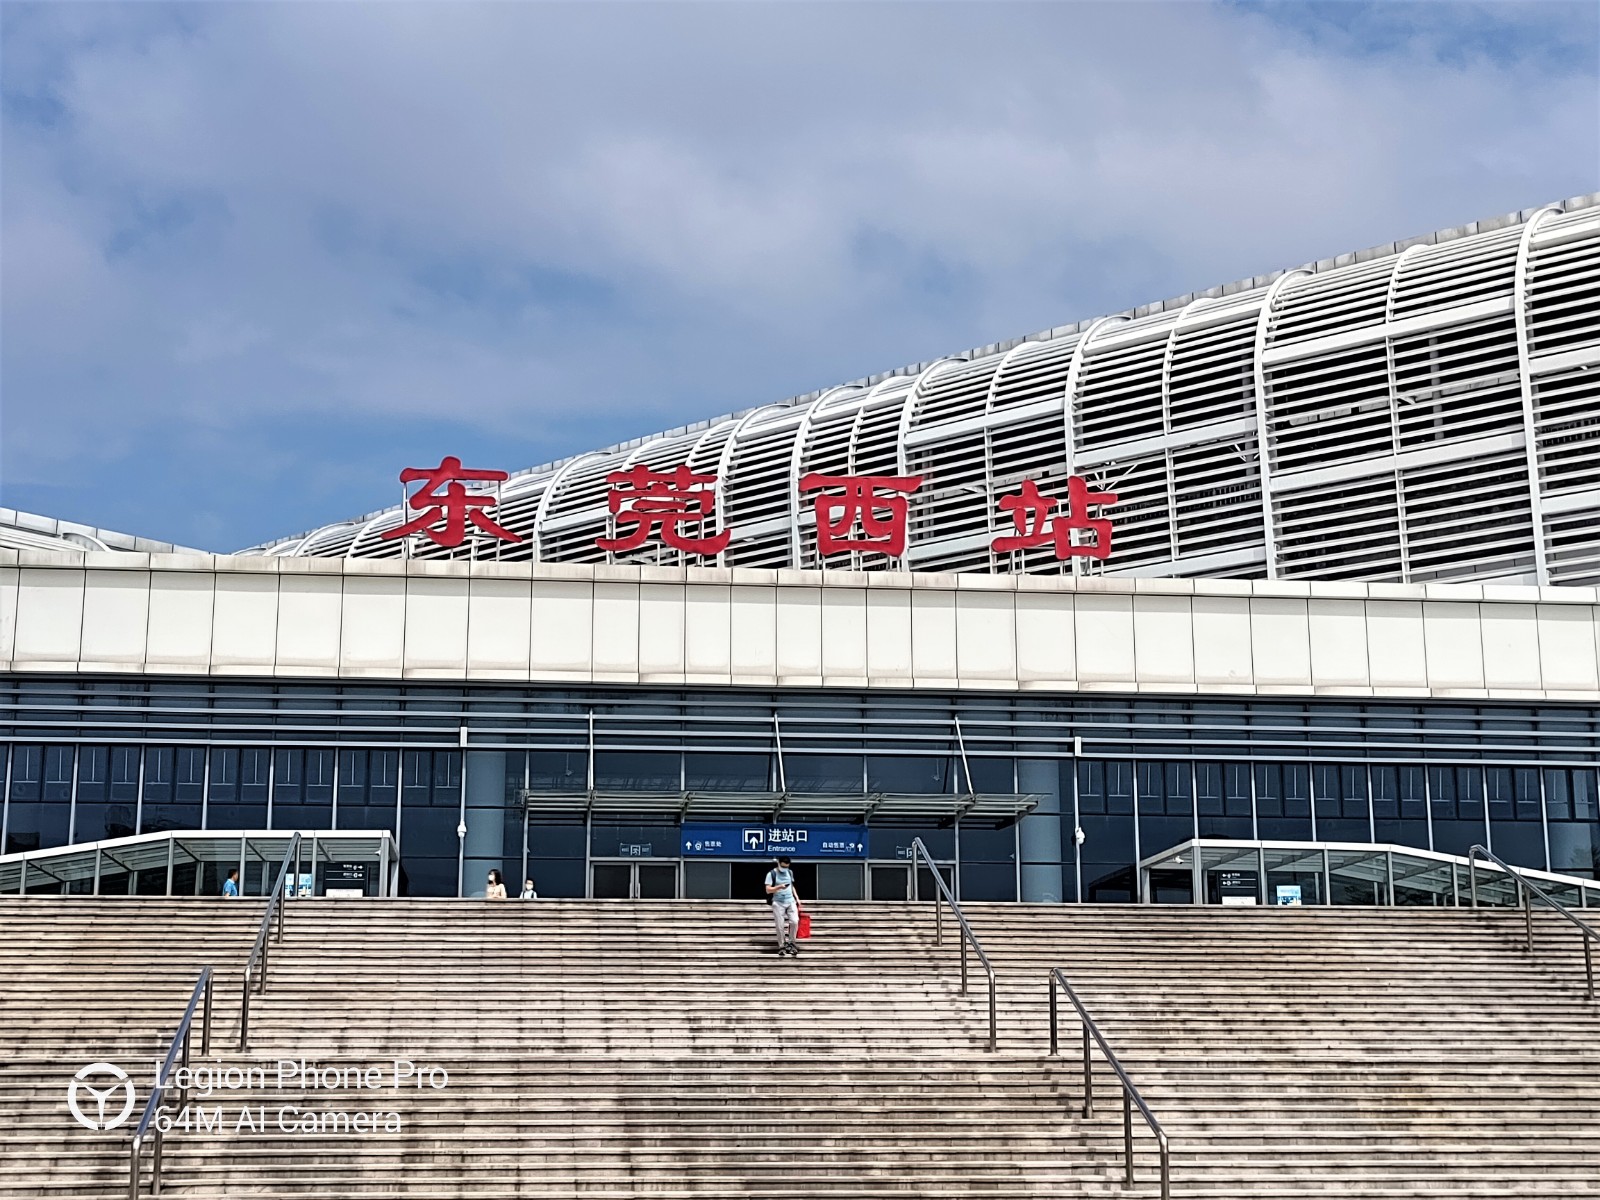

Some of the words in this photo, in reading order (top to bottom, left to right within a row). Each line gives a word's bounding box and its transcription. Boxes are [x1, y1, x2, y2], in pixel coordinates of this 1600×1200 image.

[382, 456, 1119, 561] 东莞西站
[768, 828, 808, 842] 进站口
[768, 845, 796, 853] Entrance
